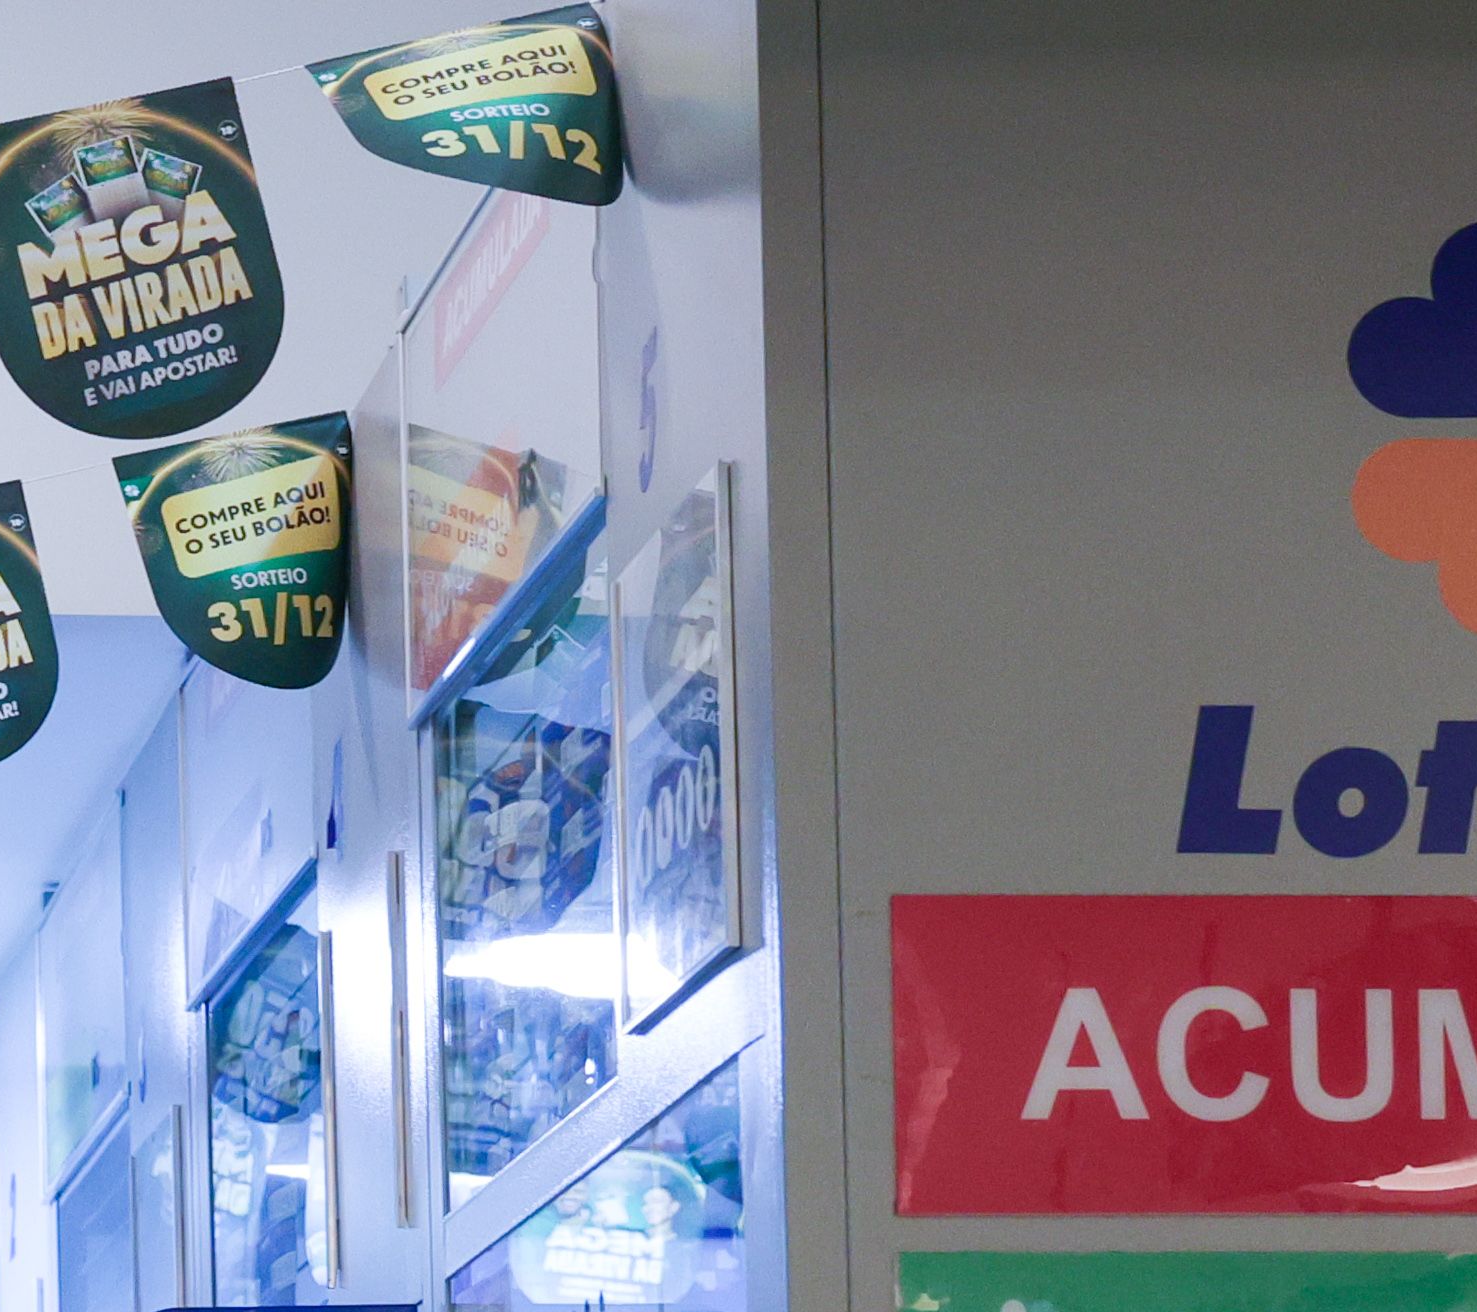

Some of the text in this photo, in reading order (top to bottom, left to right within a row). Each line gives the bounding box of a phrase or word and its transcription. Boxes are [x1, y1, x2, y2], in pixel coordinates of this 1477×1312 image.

[381, 44, 566, 96] COMPRE AQUI
[420, 59, 577, 101] SEU BOLÃO!
[449, 102, 550, 122] SORTEIO
[424, 122, 602, 174] 31/12
[17, 191, 237, 299] MEGA
[32, 253, 252, 359] DA VIRADA
[85, 324, 223, 380] PARA TUDO
[100, 347, 237, 402] VAI APOSTAR!
[175, 481, 326, 533] COMPRE AQUI
[209, 523, 246, 549] SEU
[231, 567, 307, 590] SORTEIO
